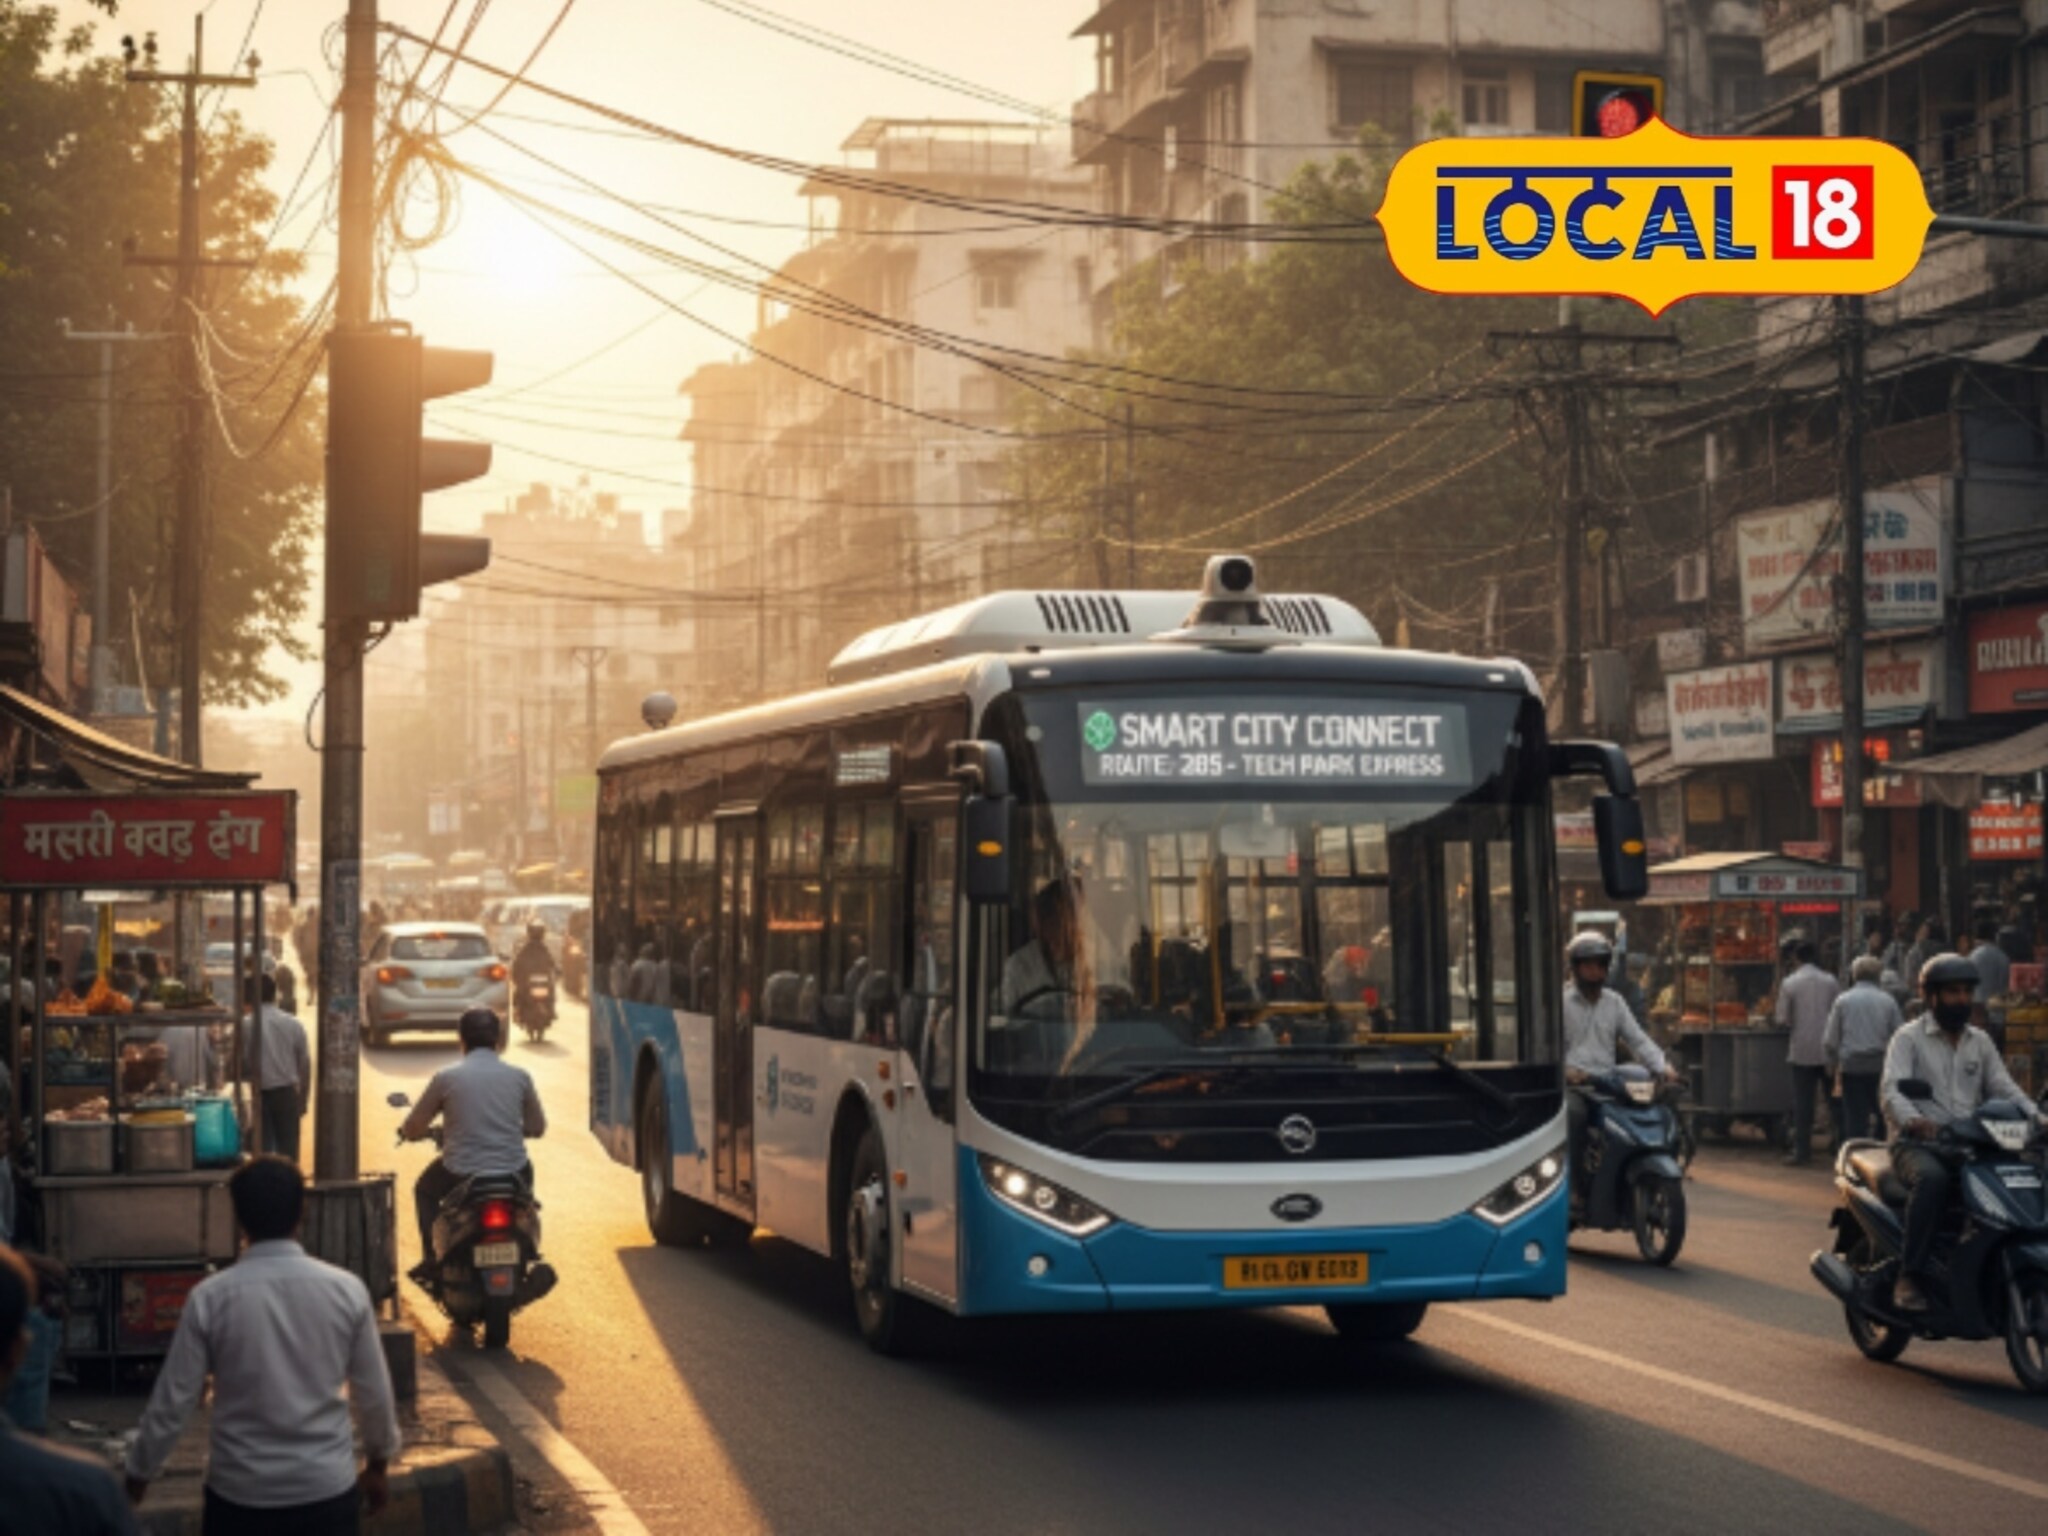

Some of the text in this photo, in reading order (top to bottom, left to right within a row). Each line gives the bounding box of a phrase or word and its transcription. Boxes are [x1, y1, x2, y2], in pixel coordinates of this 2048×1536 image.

[1120, 711, 1442, 749] SMART CITY CONNECT
[1241, 753, 1296, 777] TECH
[1300, 753, 1355, 777] PARK
[1359, 753, 1445, 777] EXPRESS
